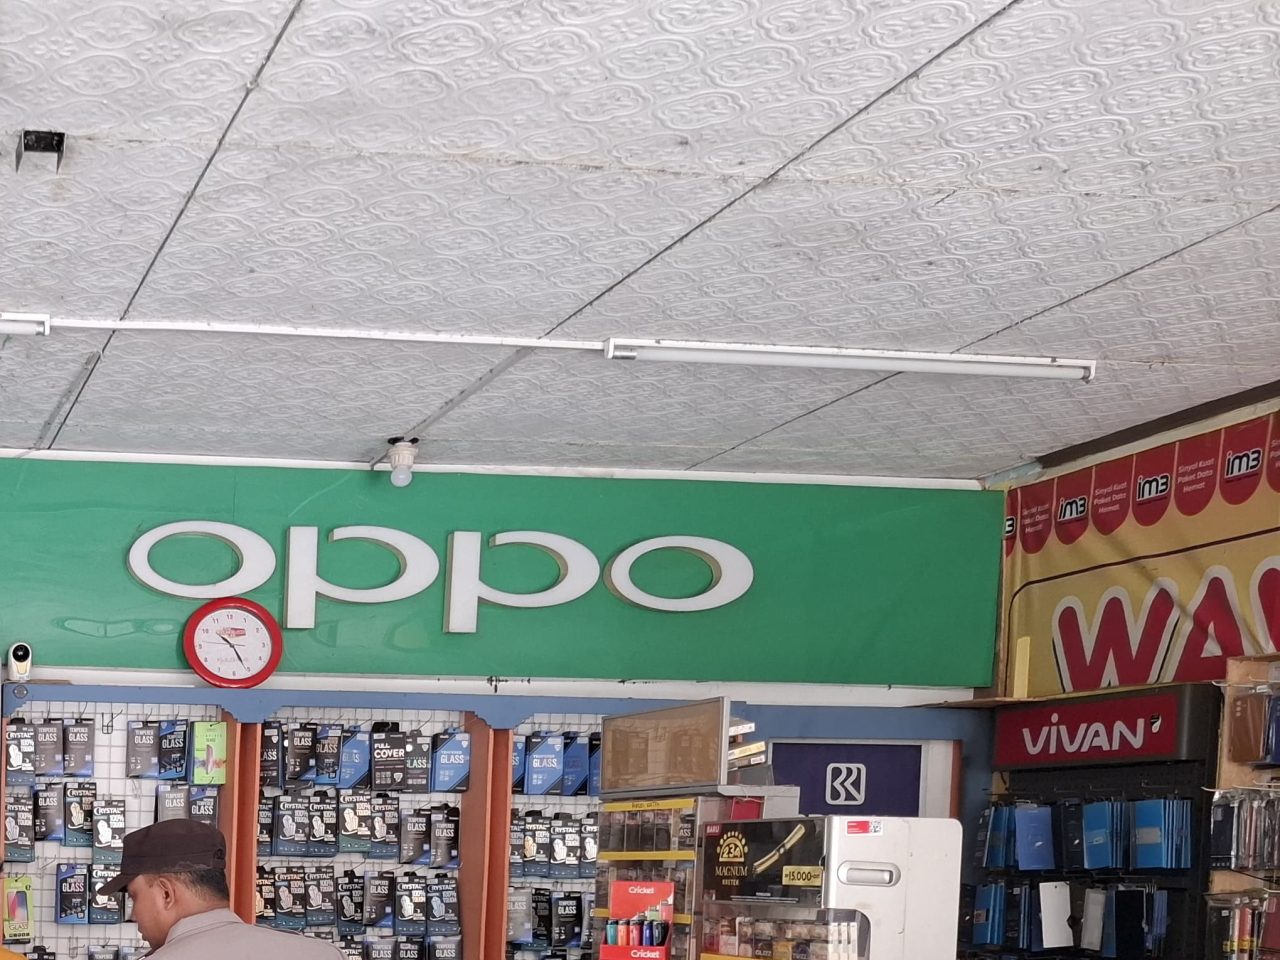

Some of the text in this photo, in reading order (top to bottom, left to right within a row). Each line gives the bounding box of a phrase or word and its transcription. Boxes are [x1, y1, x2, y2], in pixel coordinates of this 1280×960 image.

[1225, 447, 1262, 478] im3
[1136, 472, 1170, 501] im3
[1058, 495, 1088, 522] im3
[128, 520, 755, 635] oppo
[374, 749, 405, 758] COVER
[715, 866, 748, 877] MAGNUM
[628, 885, 655, 895] Cricket
[630, 949, 660, 959] Cricket
